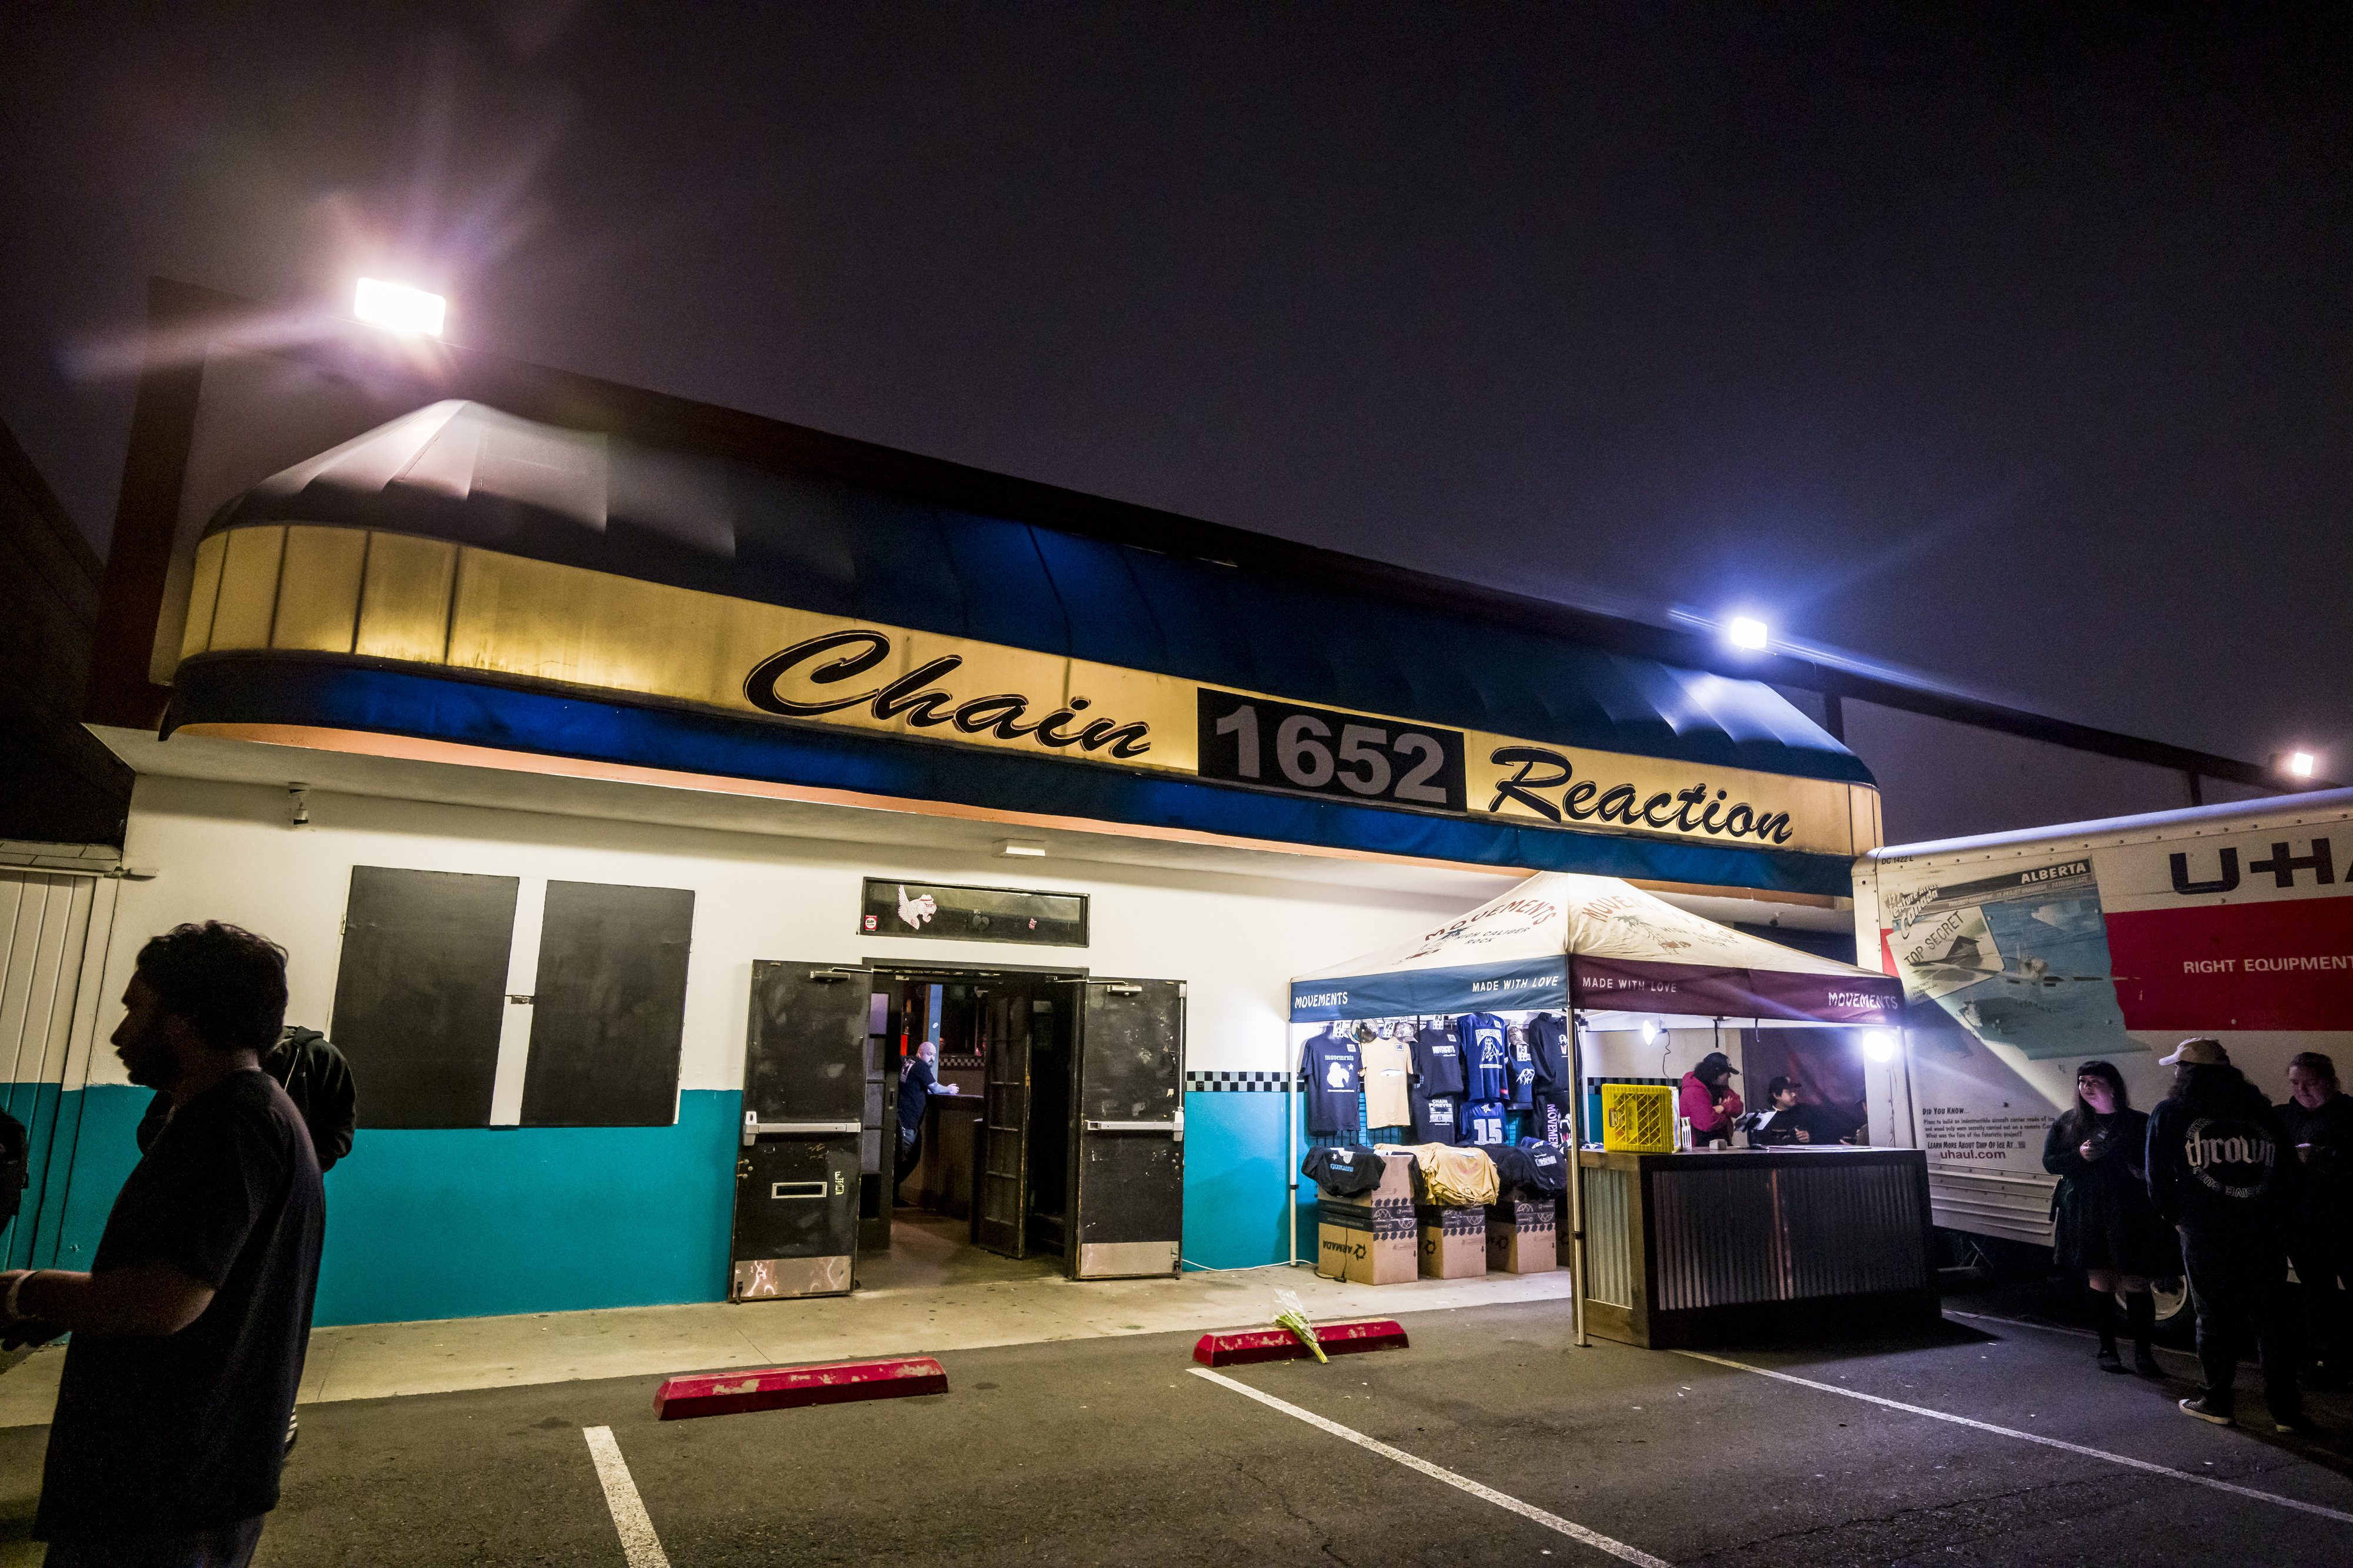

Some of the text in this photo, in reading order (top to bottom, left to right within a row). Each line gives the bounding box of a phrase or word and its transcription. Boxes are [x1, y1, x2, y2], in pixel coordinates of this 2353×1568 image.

[743, 629, 1151, 759] Chain
[1215, 705, 1448, 803] 1652
[1488, 745, 1794, 845] Reaction
[1894, 855, 1908, 863] 1422
[2169, 838, 2353, 895] U-H
[2021, 863, 2086, 883] ALBERTA
[1425, 900, 1557, 941] MOVEMENTS
[1901, 890, 1939, 939] Canada
[1482, 928, 1530, 936] CALIBER
[1904, 910, 1964, 963] TOP SECRET
[2183, 959, 2236, 973] RIGHT
[1472, 976, 1559, 992] MADE WITH LOVE
[1582, 977, 1677, 993] MADE WITH LOVE
[1295, 992, 1348, 1009] MOVEMENTS
[1828, 992, 1898, 1009] MOVEMENTS
[1474, 1119, 1502, 1146] 15
[1941, 1150, 2006, 1159] uhaul.com
[2185, 1130, 2276, 1170] thrown
[1323, 1240, 1352, 1254] ARMADA
